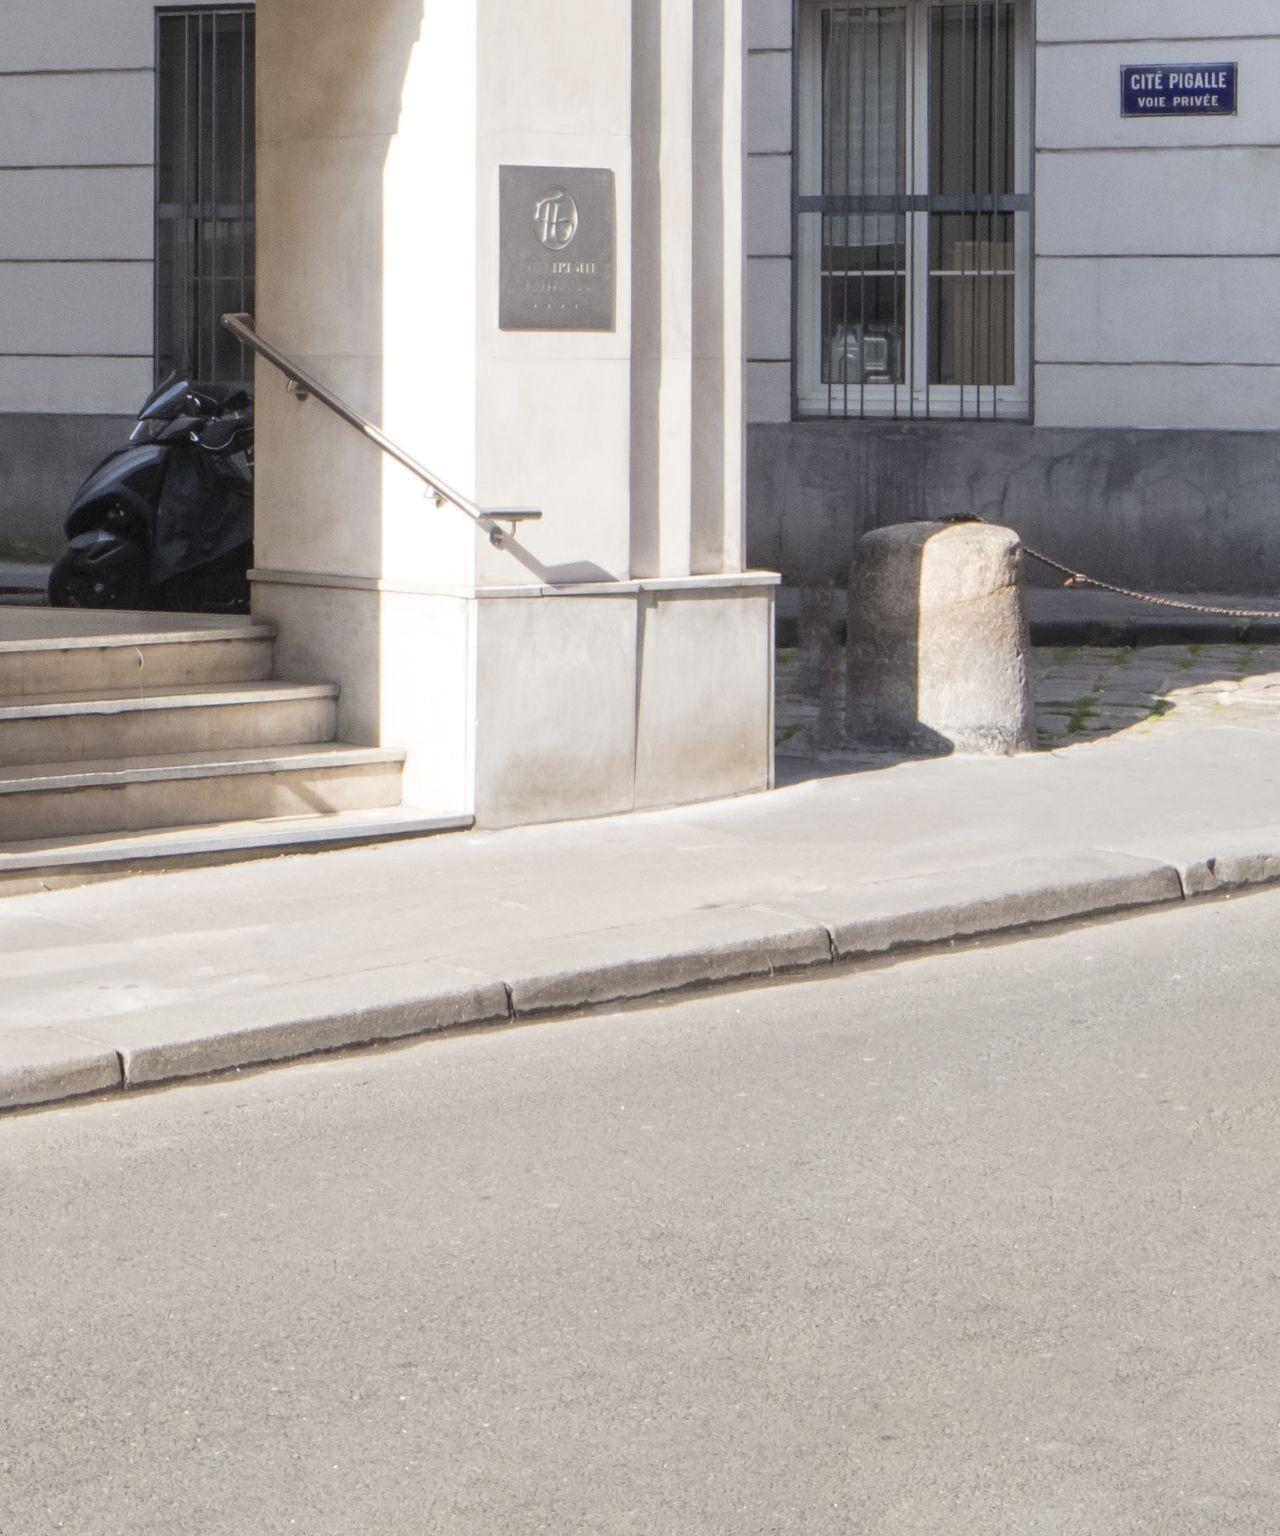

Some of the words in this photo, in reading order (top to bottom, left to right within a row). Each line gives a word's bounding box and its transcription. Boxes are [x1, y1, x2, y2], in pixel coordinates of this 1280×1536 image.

[1131, 70, 1163, 90] CITÉ
[1169, 71, 1227, 89] PIGALLE
[1138, 96, 1166, 107] VOIE
[1173, 93, 1219, 107] PRIVÉE
